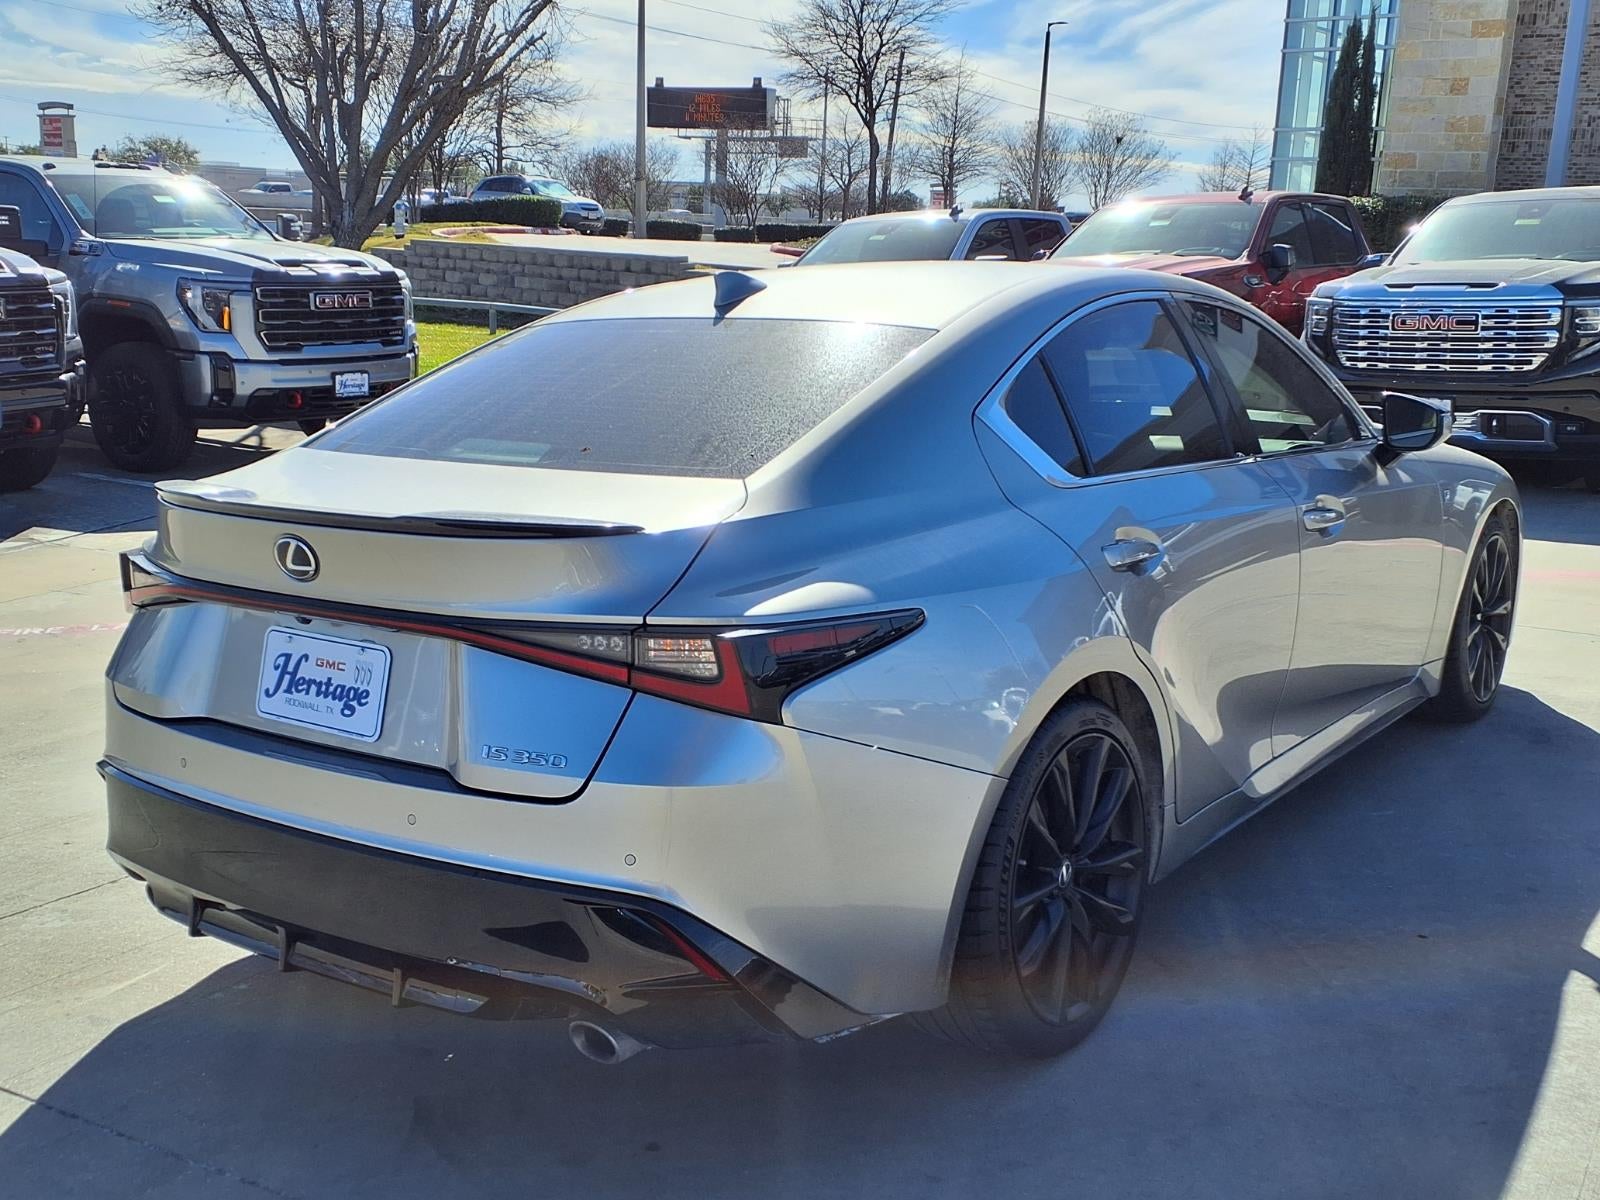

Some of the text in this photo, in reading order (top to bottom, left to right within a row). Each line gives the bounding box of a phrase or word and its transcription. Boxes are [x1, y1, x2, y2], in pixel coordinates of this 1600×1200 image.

[316, 294, 370, 308] GMC
[1394, 315, 1476, 330] GMC
[315, 657, 346, 672] GMC
[264, 652, 370, 718] Heritage
[326, 705, 334, 715] TX
[481, 744, 568, 768] IS 350
